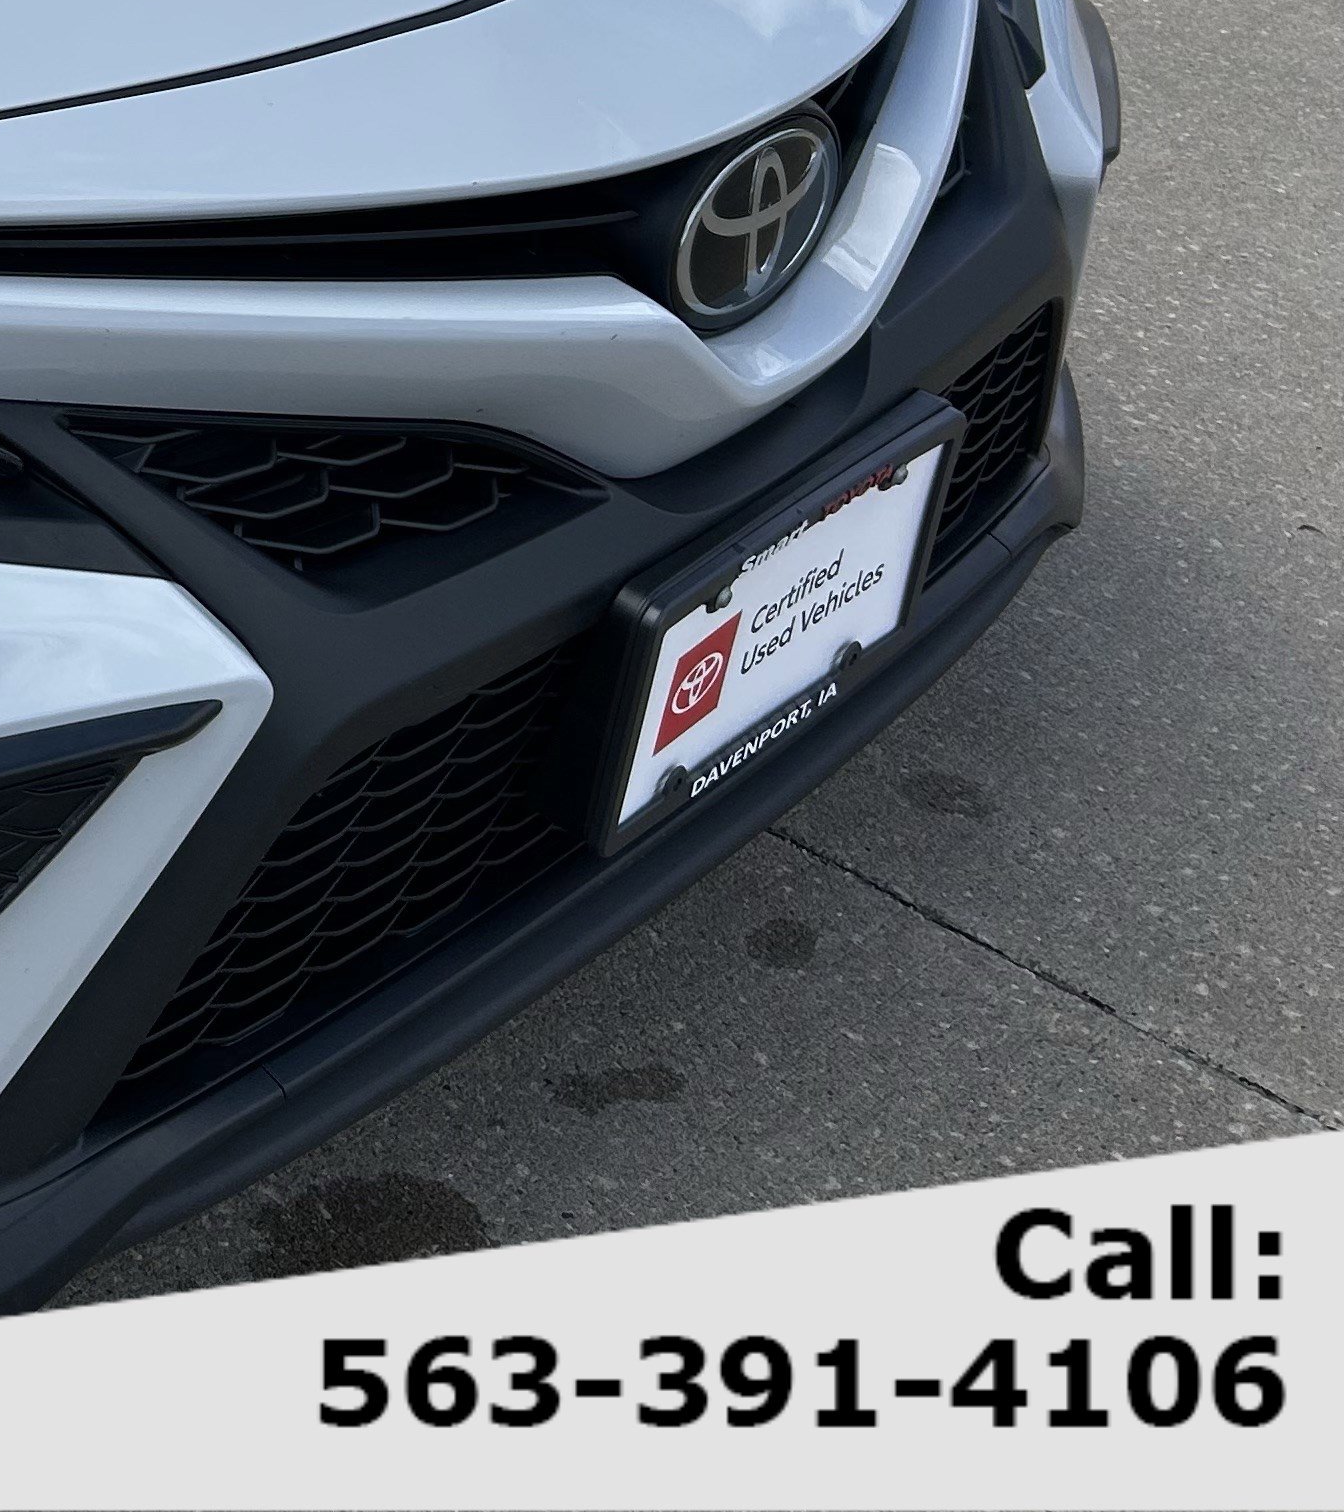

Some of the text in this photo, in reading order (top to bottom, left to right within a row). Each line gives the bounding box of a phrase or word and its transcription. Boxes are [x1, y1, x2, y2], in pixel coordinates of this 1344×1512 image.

[740, 562, 885, 675] Used Vehicles
[750, 548, 845, 634] Certified
[690, 682, 838, 798] DAVENPORT, IA
